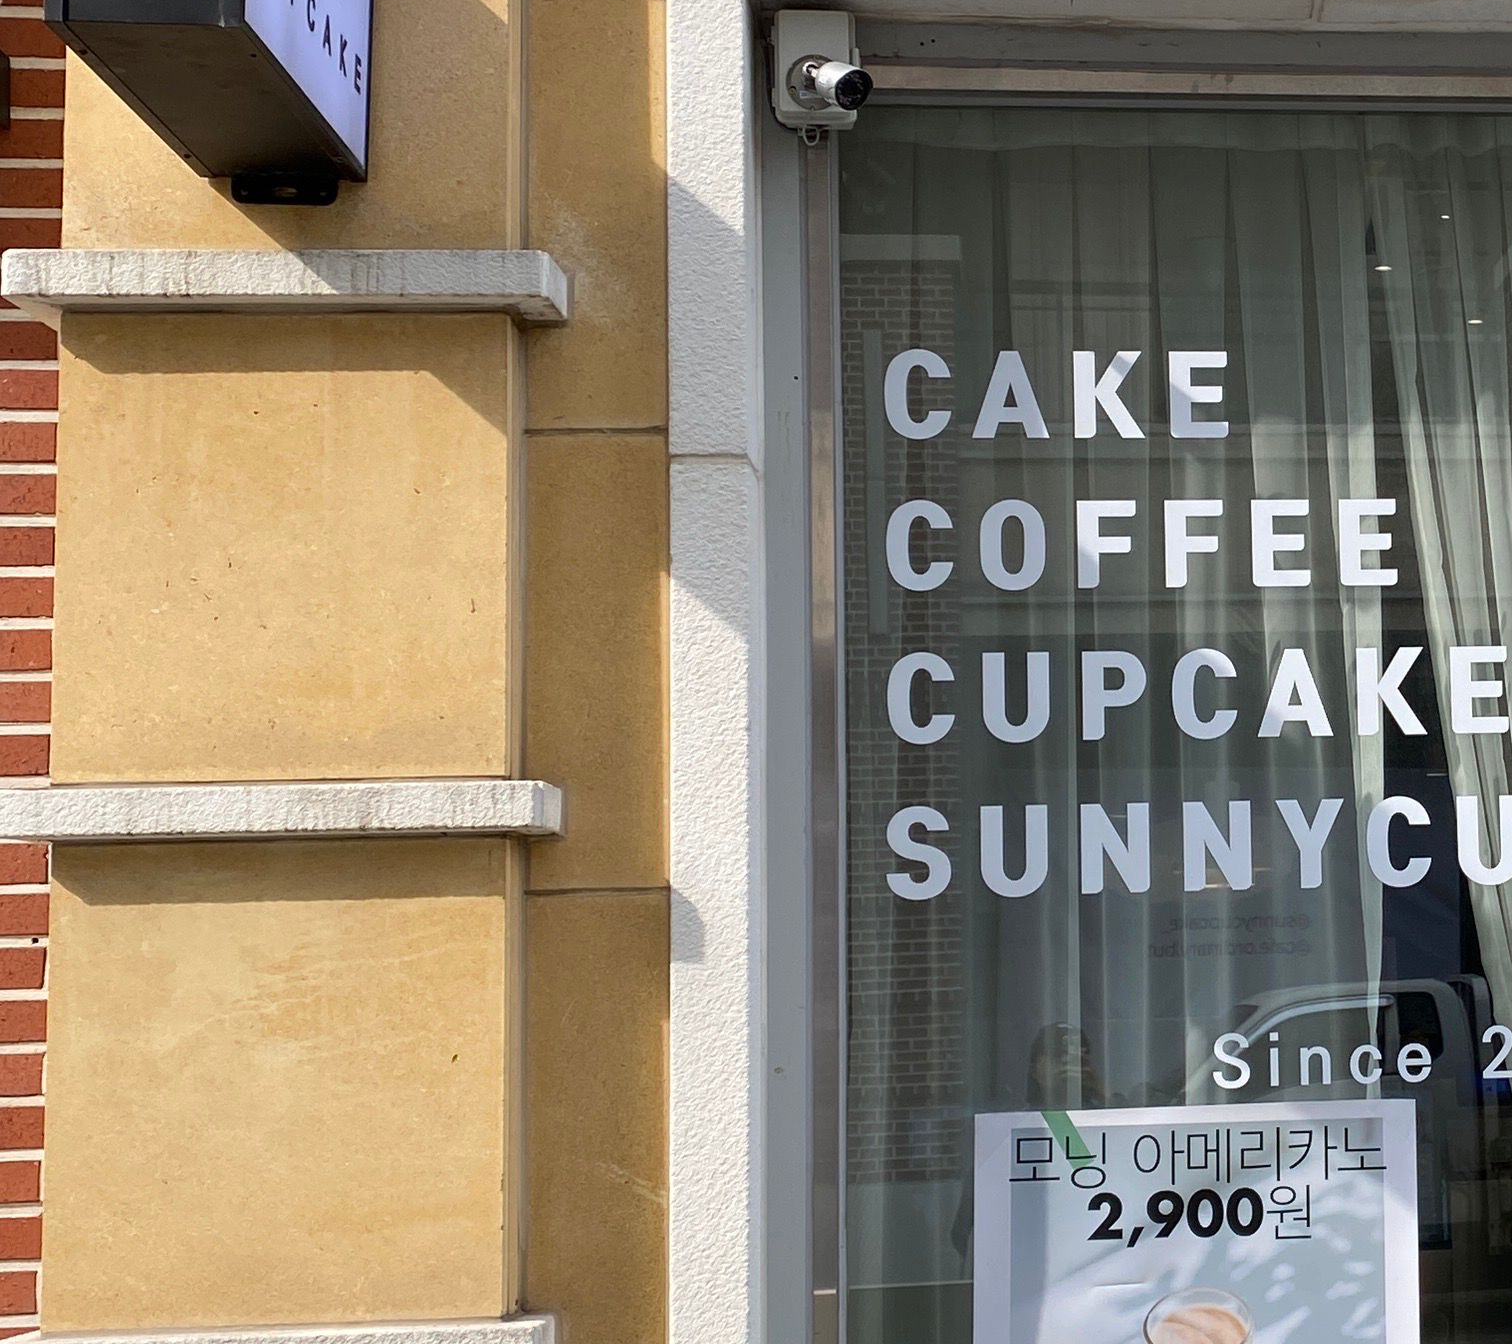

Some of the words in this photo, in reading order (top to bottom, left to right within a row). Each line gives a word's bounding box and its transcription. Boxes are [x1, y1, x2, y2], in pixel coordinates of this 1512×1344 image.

[883, 348, 1230, 441] CAKE
[884, 497, 1399, 592] COFFEE
[886, 644, 1511, 745] CUPCAKE
[1212, 1030, 1433, 1090] Since
[1008, 1132, 1107, 1189] 모닝
[1133, 1125, 1388, 1185] 아메리카노
[1086, 1184, 1313, 1249] 2,900원
